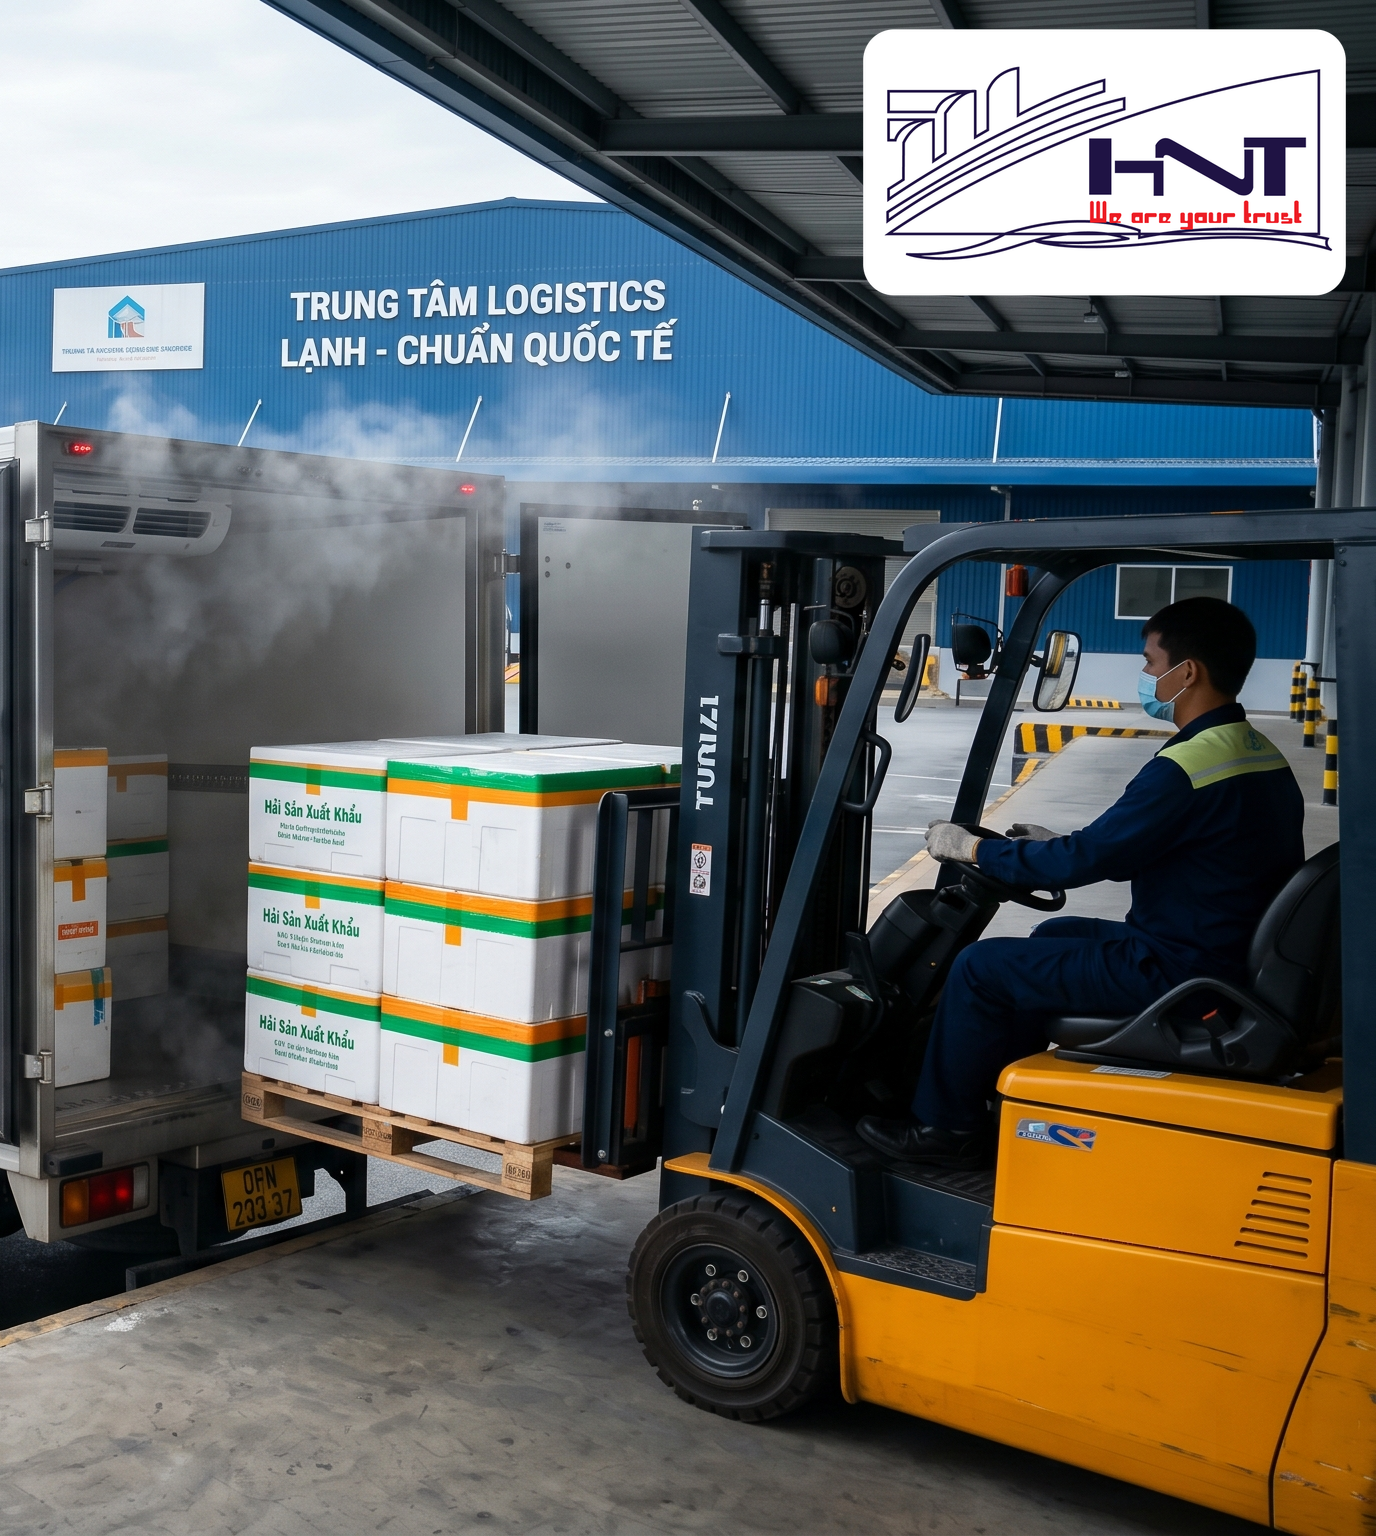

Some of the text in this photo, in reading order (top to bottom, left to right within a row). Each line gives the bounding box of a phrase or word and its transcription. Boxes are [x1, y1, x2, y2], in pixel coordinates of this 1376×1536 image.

[290, 278, 666, 322] TRUNG TÂM LOGISTICS
[281, 336, 366, 373] LẠNH
[397, 321, 514, 365] CHUẨN
[523, 320, 621, 366] QUỐC
[630, 318, 678, 361] TẾ
[264, 798, 281, 815] Hải
[306, 802, 331, 821] Xuất
[334, 803, 362, 824] Khẩu
[263, 907, 360, 938] Hải Sản Xuất Khẩu
[259, 1014, 276, 1032] Hải
[279, 1019, 297, 1037] Sản
[300, 1024, 325, 1043] Xuất
[327, 1029, 355, 1051] Khẩu
